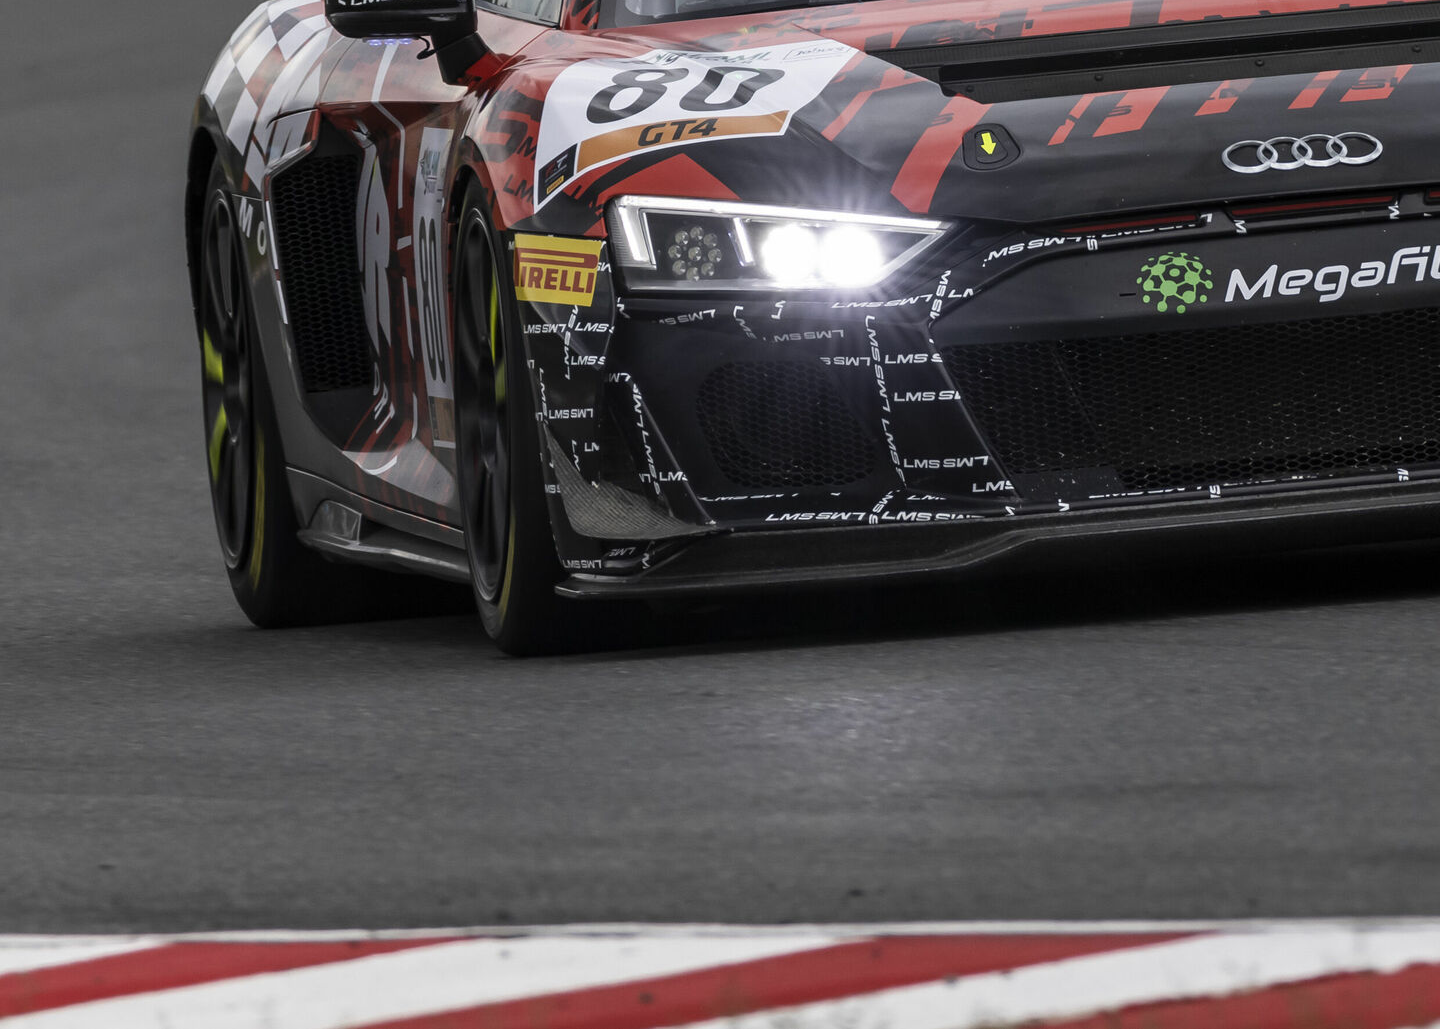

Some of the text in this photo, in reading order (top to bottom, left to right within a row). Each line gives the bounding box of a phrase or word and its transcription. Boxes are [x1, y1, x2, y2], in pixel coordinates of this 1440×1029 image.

[587, 66, 785, 124] 80
[638, 118, 719, 147] GT4
[514, 247, 599, 295] PIRELLI
[893, 392, 935, 401] LMS
[903, 458, 940, 469] LMS
